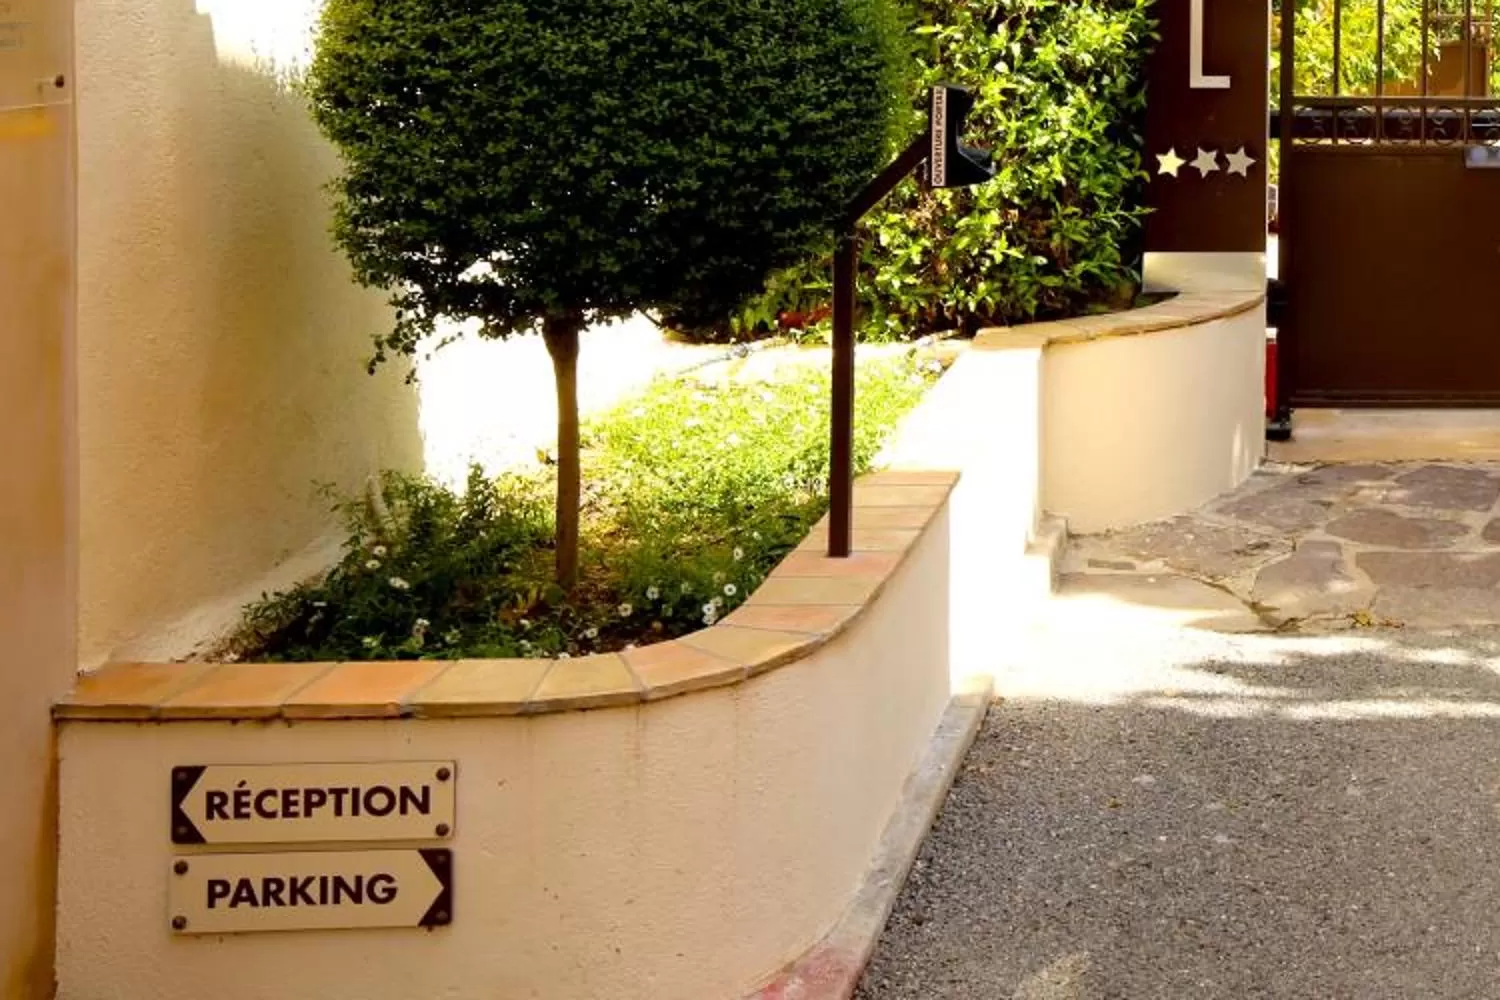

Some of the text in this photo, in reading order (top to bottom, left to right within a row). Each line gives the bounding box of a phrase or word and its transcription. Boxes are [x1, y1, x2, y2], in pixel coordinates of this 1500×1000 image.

[933, 87, 944, 185] OUVERTURE PORTAI
[205, 779, 431, 820] RÉCEPTION
[206, 873, 399, 909] PARKING
